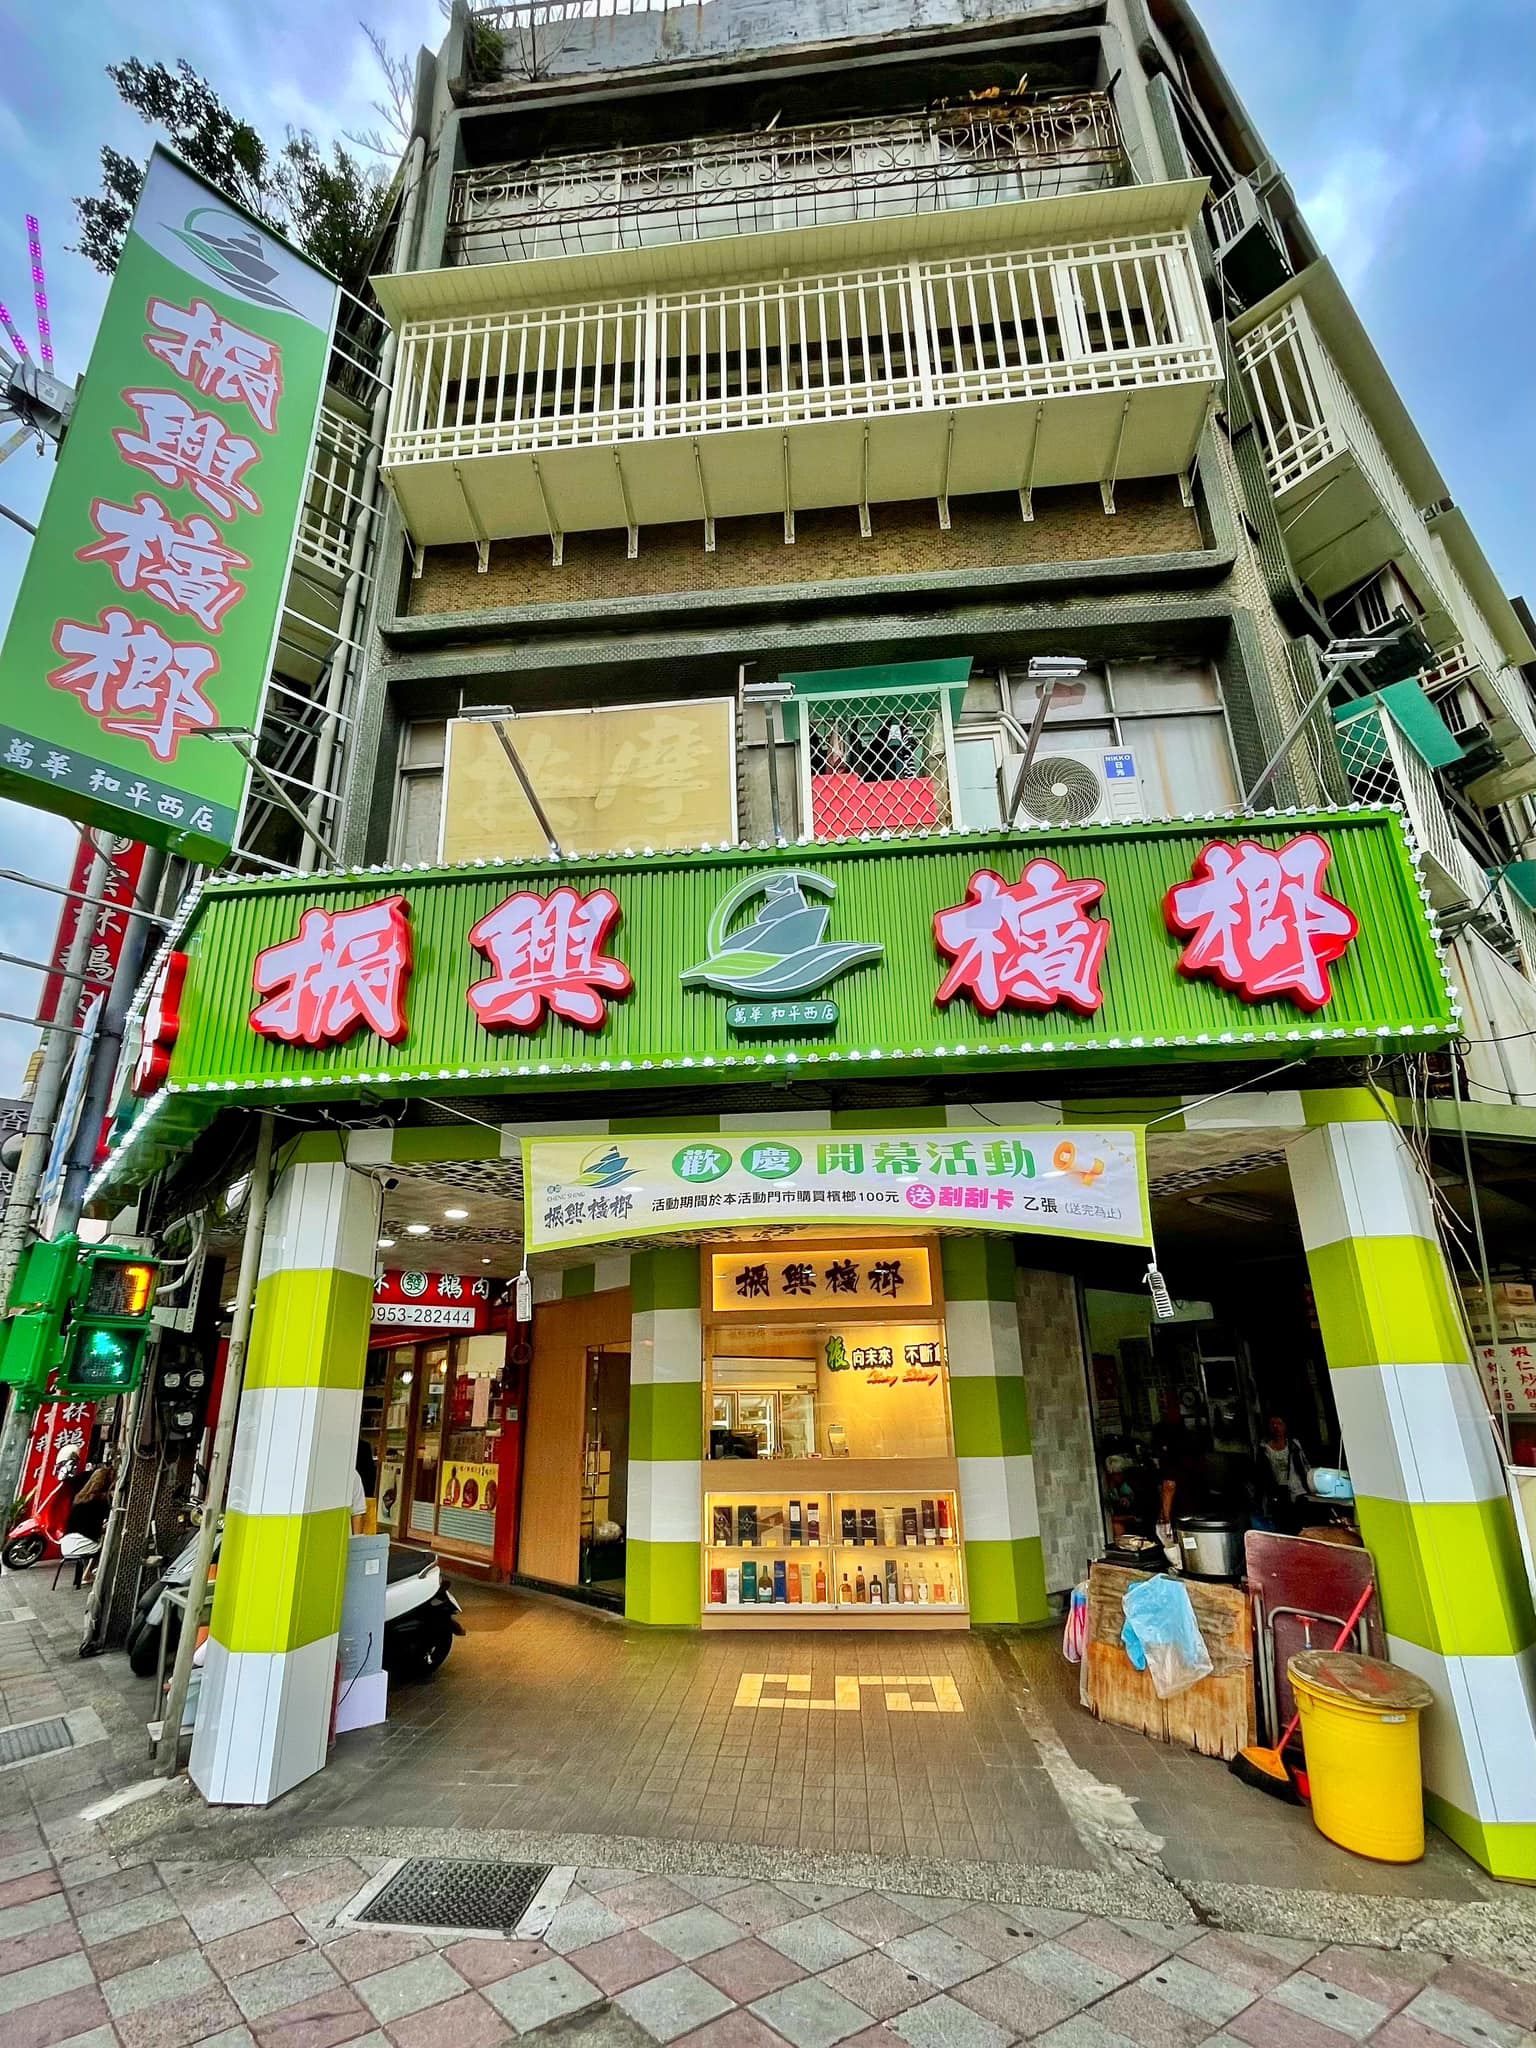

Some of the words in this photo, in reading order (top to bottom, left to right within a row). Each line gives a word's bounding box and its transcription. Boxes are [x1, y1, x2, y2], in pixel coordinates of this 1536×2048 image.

[47, 296, 286, 762] 振興檳榔
[1105, 754, 1131, 762] NIKKO
[3, 737, 71, 778] 萬華
[89, 767, 216, 834] 和平西店
[250, 886, 633, 1048] 振興
[934, 833, 1358, 1015] 檳榔
[734, 1007, 763, 1023] 萬華
[771, 1004, 834, 1021] 和平西店
[544, 1193, 634, 1229] 振興檳榔
[1024, 1195, 1058, 1214] 乙張
[736, 1259, 904, 1298] 振興檳榔
